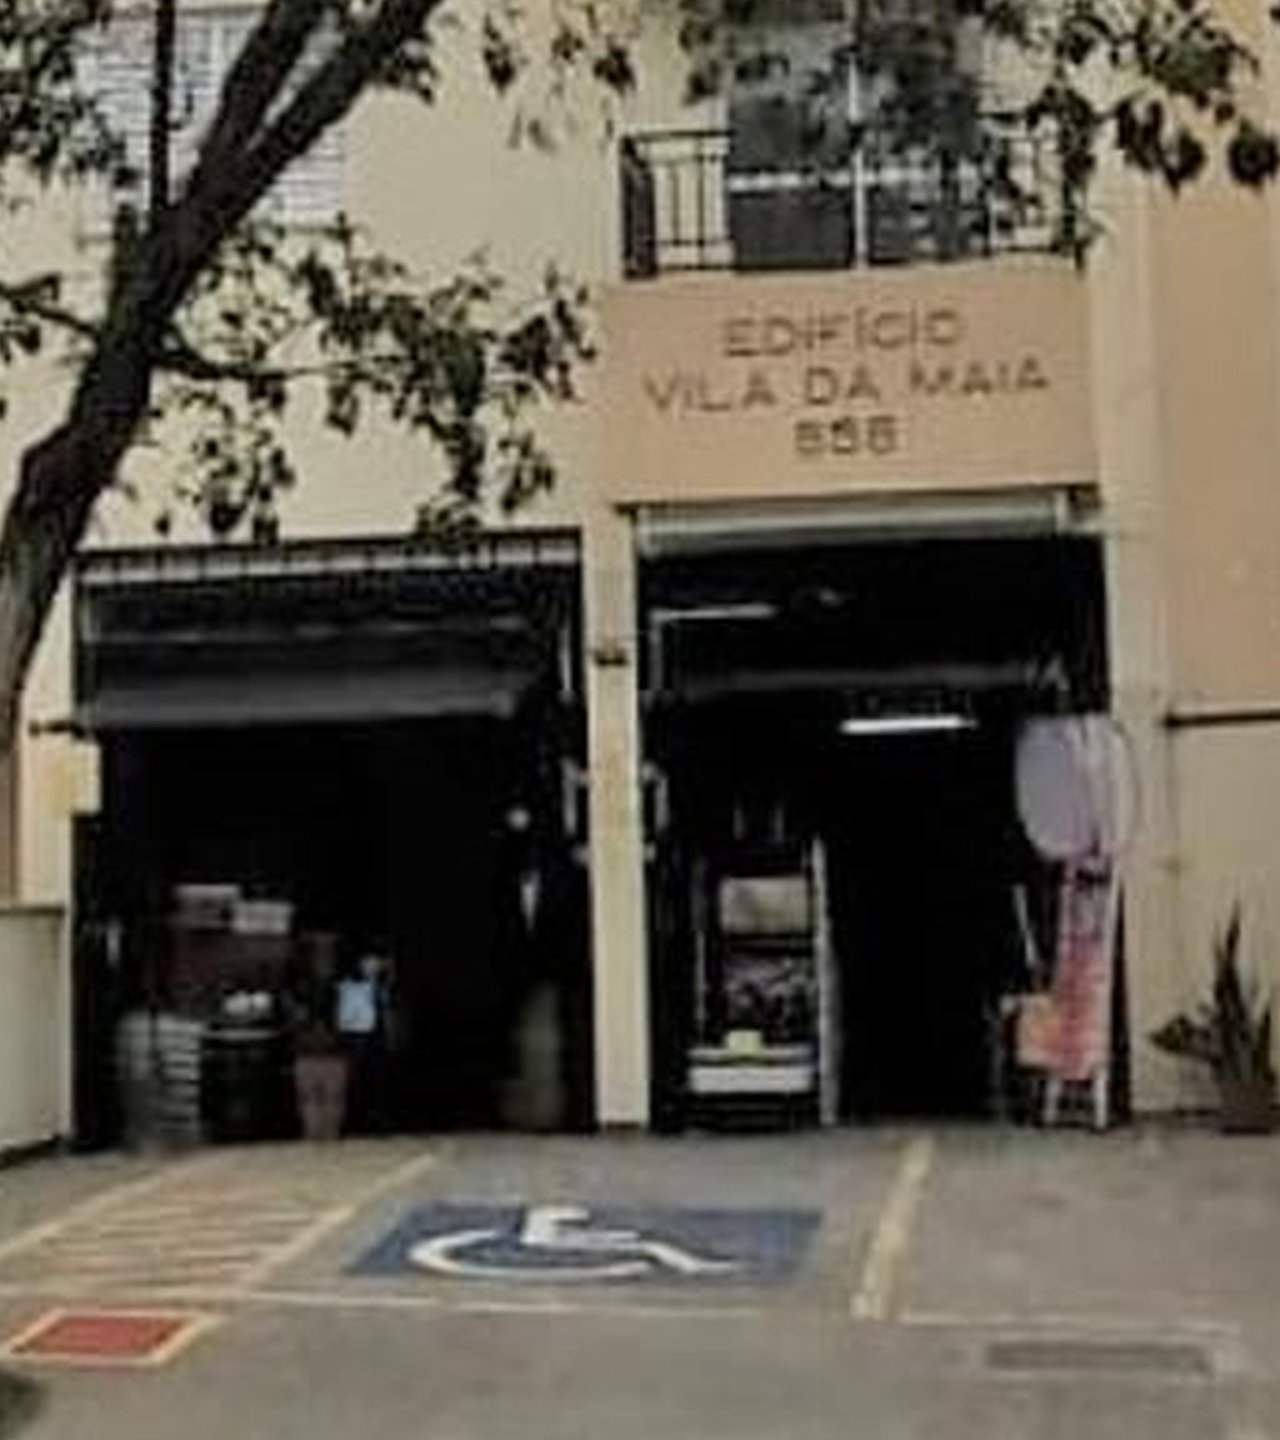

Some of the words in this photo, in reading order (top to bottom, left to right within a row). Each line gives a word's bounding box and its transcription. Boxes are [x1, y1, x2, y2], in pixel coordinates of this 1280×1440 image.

[642, 367, 777, 413] VILA
[803, 366, 881, 407] DA
[909, 355, 1051, 397] MAIA
